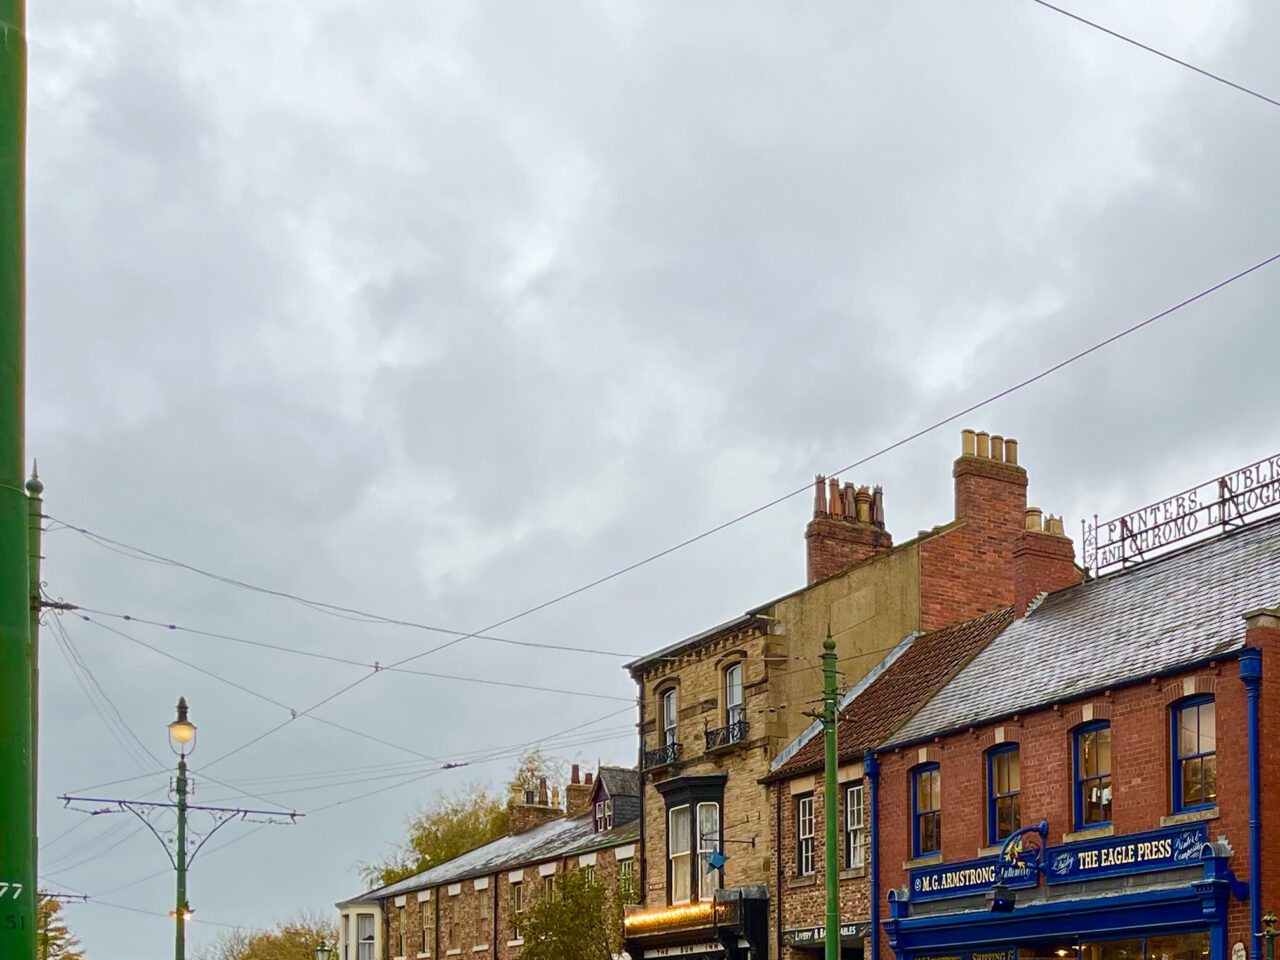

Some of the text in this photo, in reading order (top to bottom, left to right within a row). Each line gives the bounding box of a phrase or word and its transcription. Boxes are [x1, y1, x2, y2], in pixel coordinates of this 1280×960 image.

[1130, 515, 1198, 553] CHROMO
[1078, 852, 1099, 869] THE
[1101, 846, 1135, 867] EAGLE
[1138, 839, 1172, 865] PRESS
[941, 866, 995, 889] ARMSTRONG
[680, 946, 693, 954] SUN
